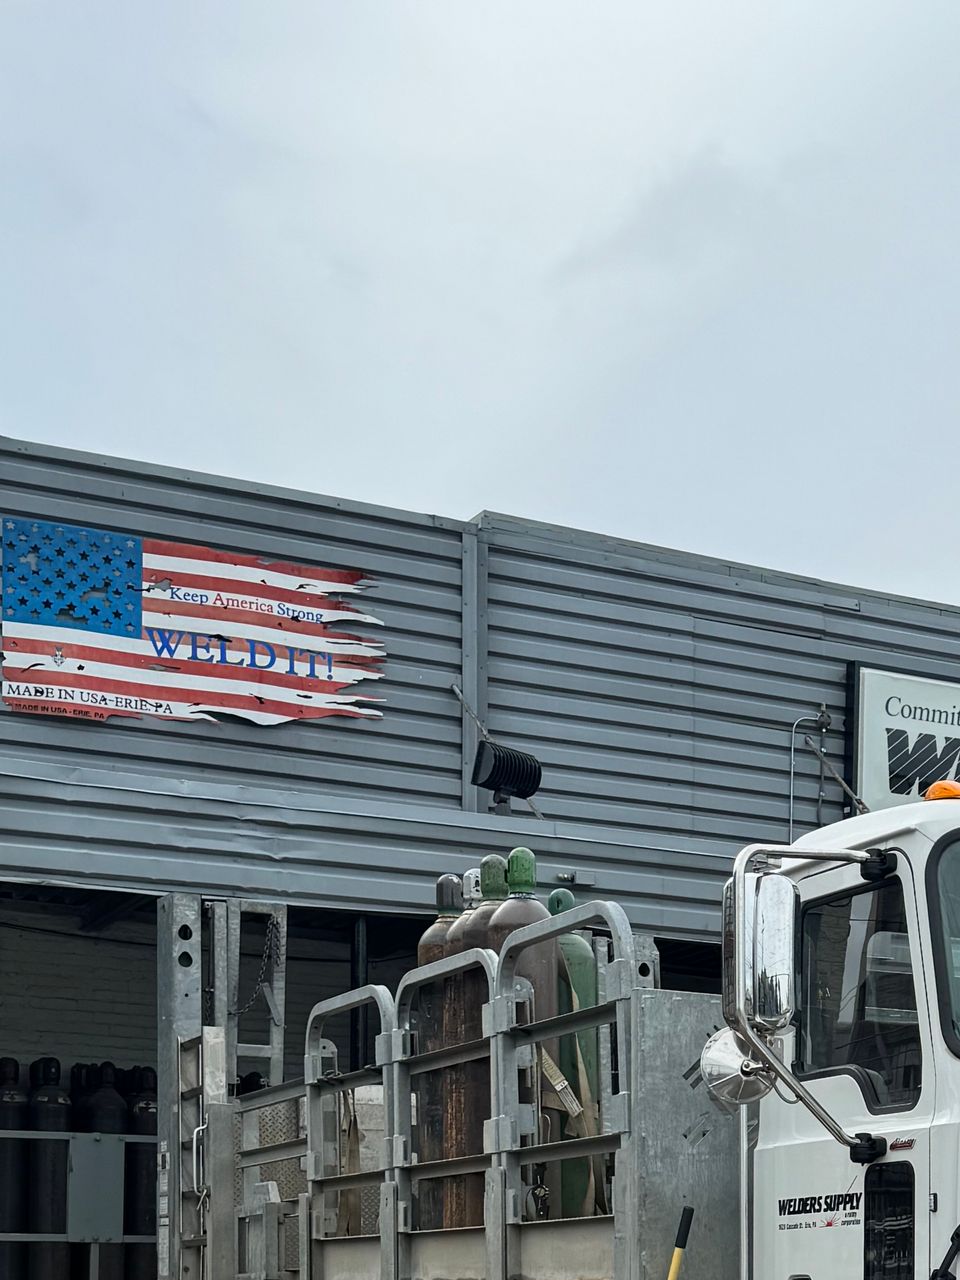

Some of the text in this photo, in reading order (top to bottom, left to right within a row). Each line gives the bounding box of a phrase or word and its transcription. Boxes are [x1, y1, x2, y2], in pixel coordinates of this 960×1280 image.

[169, 587, 323, 623] Keep America Strong
[144, 628, 334, 680] WELD IT!
[7, 683, 54, 698] MADE
[58, 688, 75, 701] IN
[154, 699, 173, 714] PA
[15, 703, 38, 712] MADE
[51, 706, 67, 715] USA
[94, 711, 105, 720] PA
[778, 1192, 863, 1216] WELDERS SUPPLY
